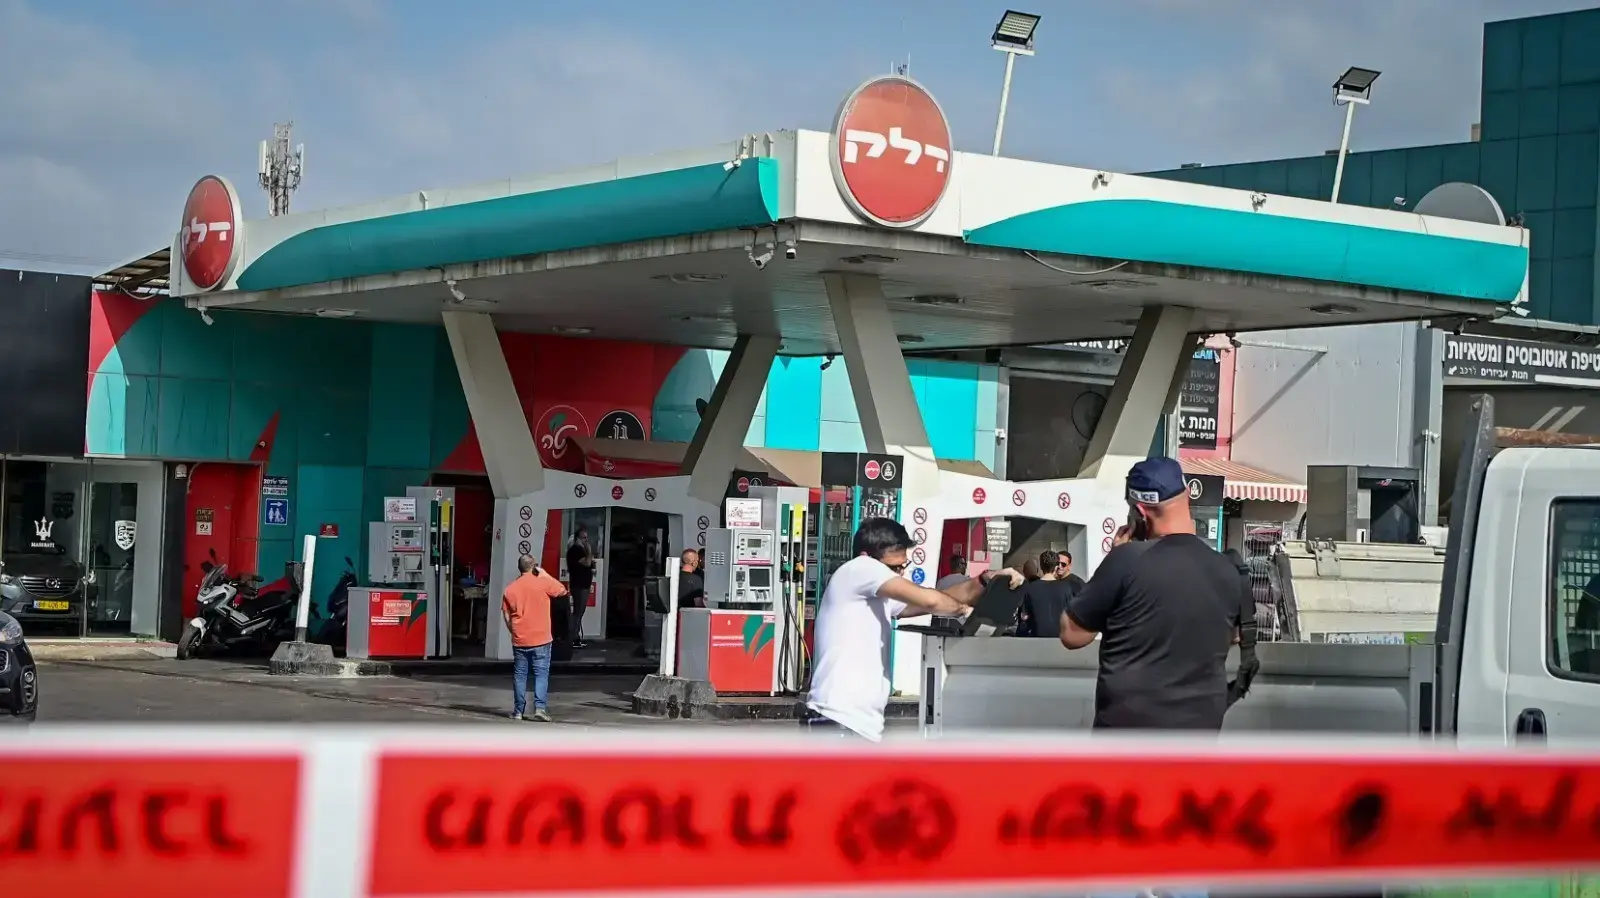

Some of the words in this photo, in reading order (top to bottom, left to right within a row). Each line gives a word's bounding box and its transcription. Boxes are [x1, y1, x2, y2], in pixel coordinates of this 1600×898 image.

[844, 127, 948, 173] דלק
[1193, 349, 1213, 359] EAM
[1447, 340, 1502, 363] ומשאיות
[1505, 345, 1567, 369] אוטובוסים
[1480, 367, 1509, 379] אביזרים
[1511, 369, 1529, 380] חנות
[1189, 382, 1216, 393] שטיפת
[1189, 394, 1216, 404] שטיפת
[1188, 416, 1216, 430] חנות
[421, 785, 799, 849] משטרת
[999, 784, 1277, 853] ישראל
